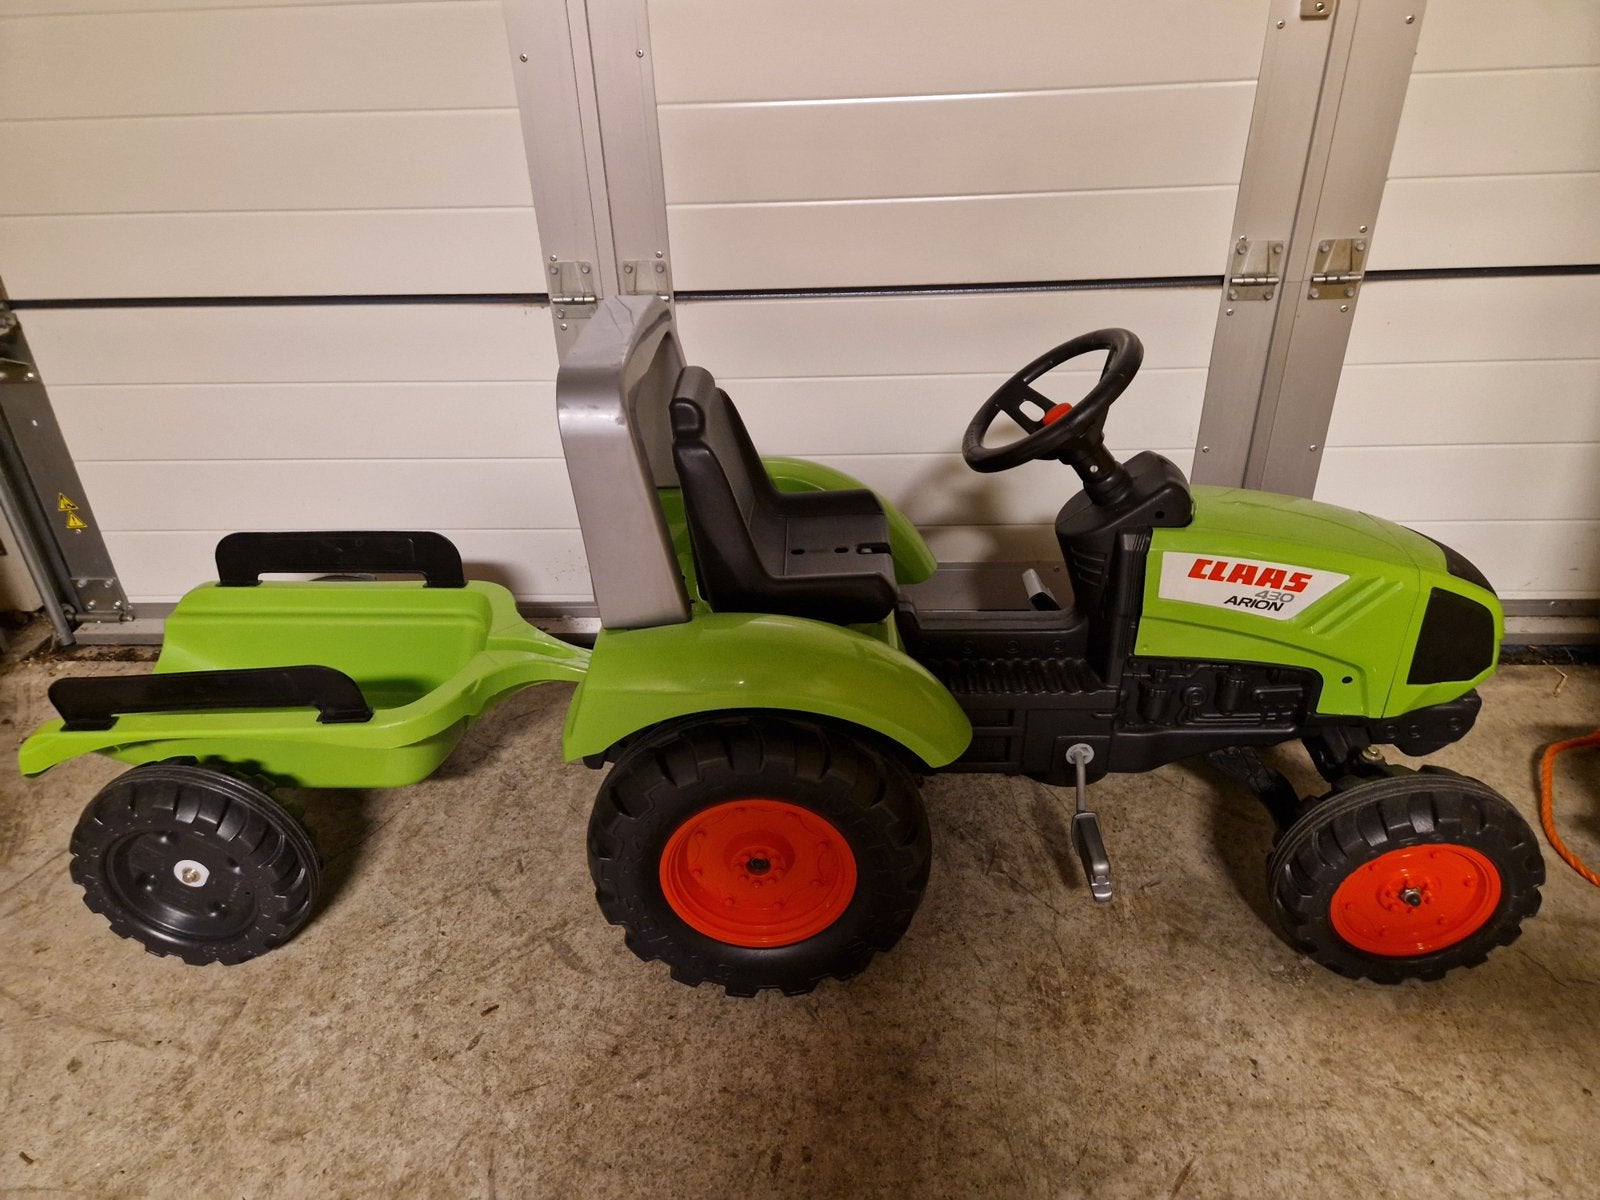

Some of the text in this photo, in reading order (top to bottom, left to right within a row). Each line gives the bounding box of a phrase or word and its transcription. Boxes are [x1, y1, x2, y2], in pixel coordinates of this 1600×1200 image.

[1188, 558, 1313, 592] CLAAS
[1224, 595, 1284, 612] ARION
[1254, 590, 1295, 603] 430
